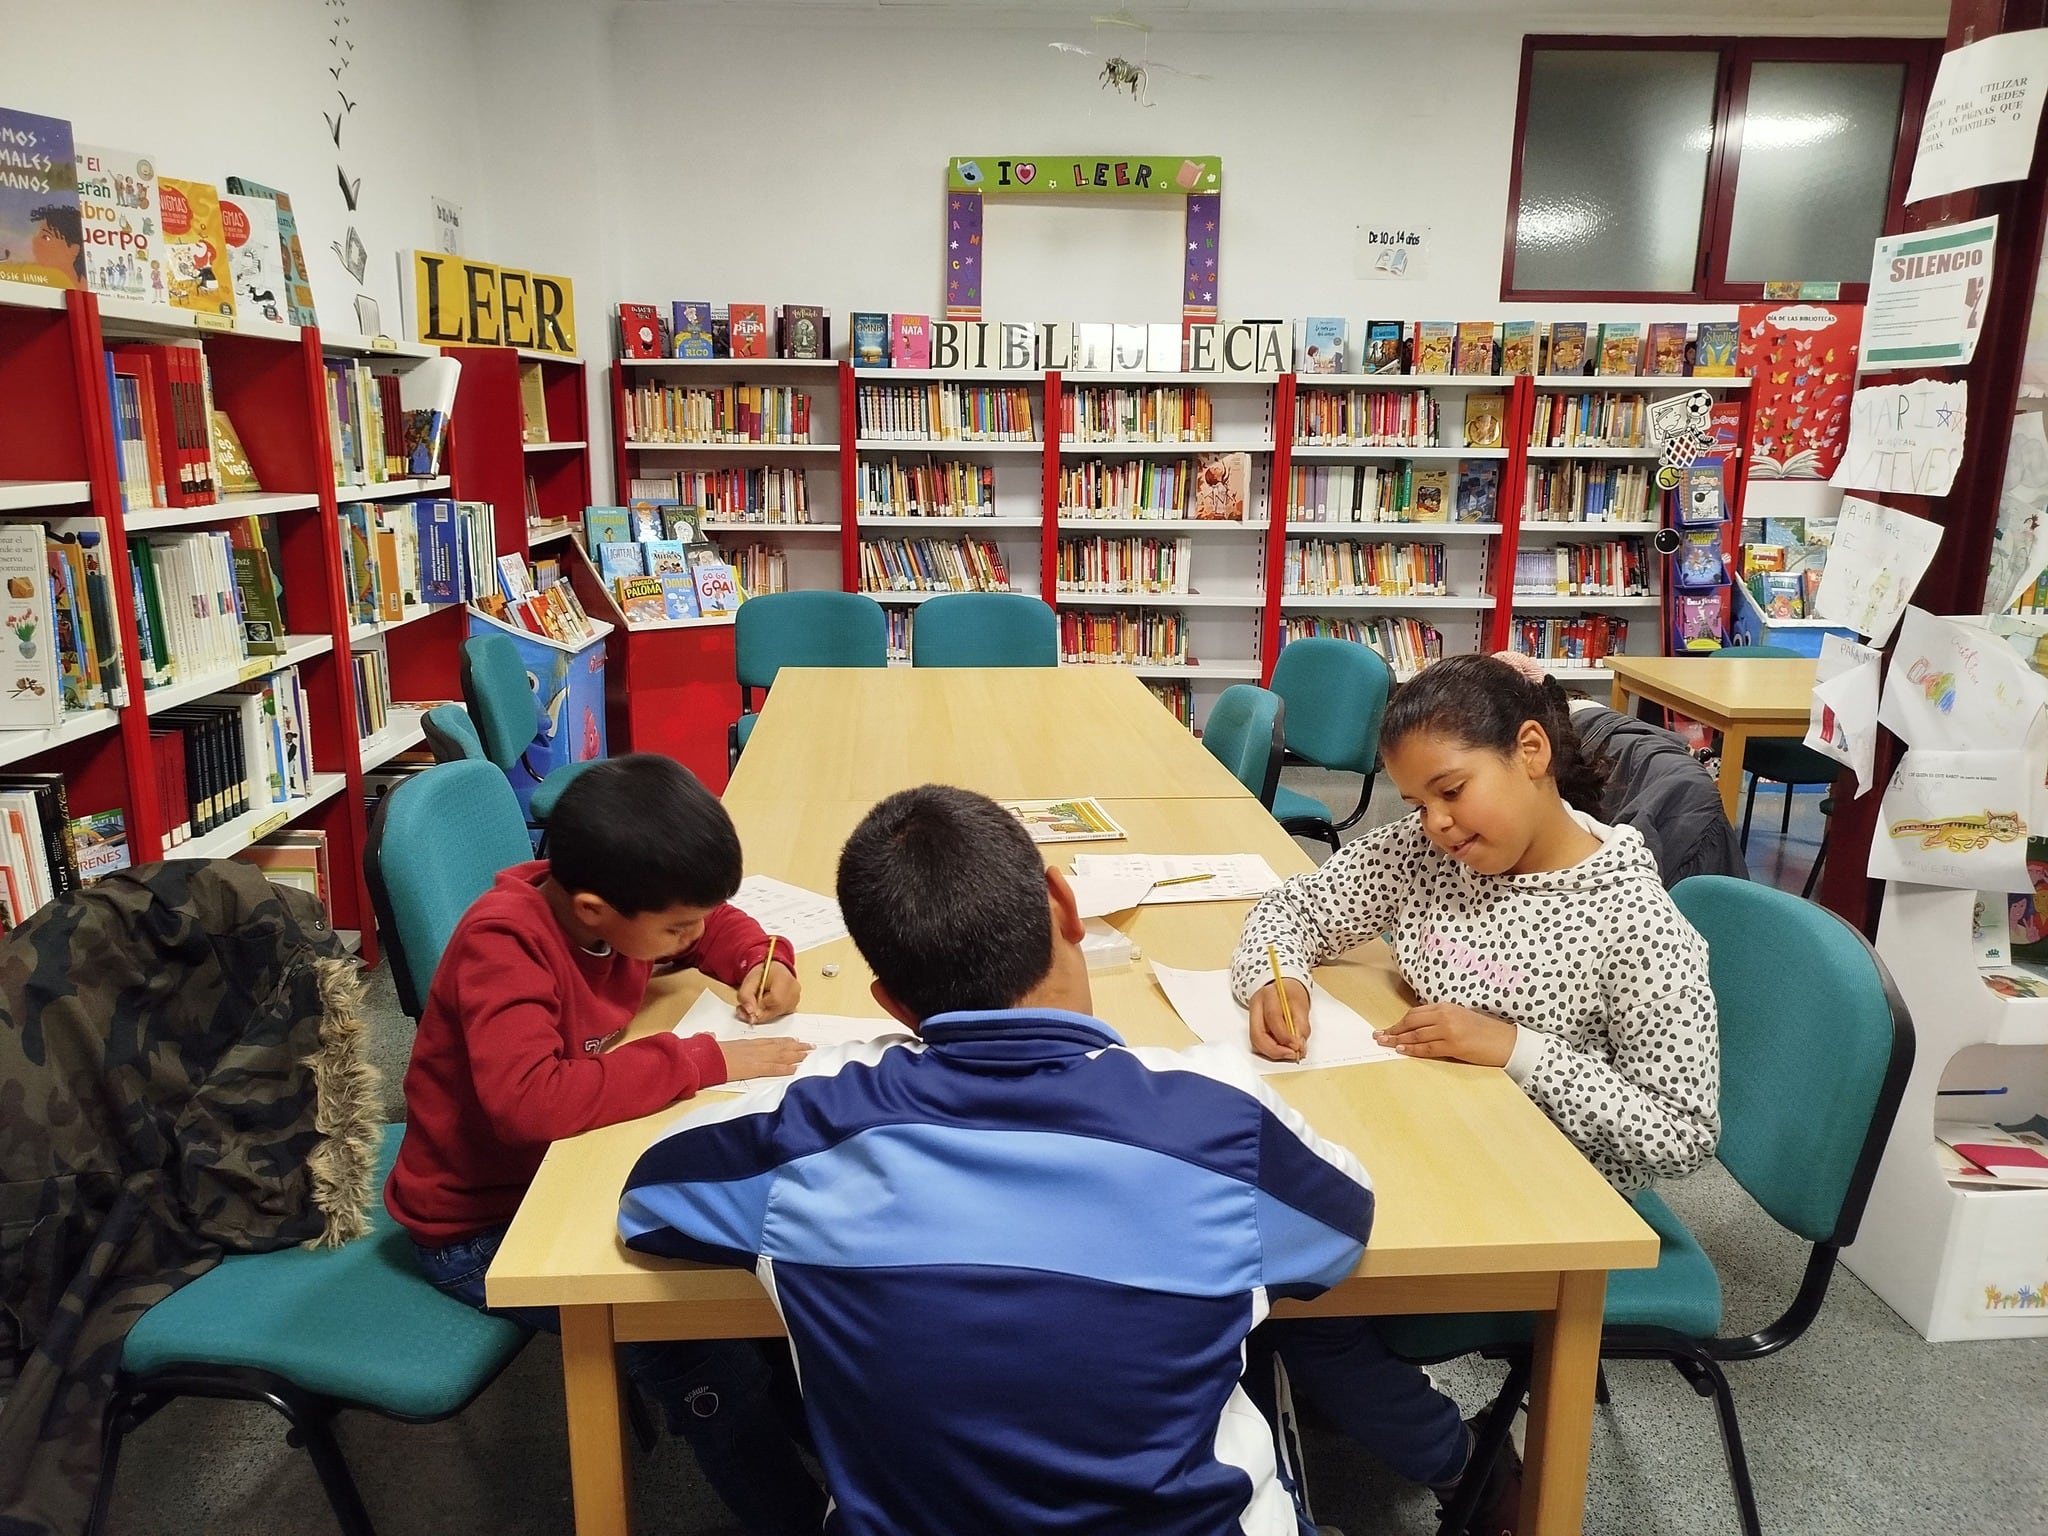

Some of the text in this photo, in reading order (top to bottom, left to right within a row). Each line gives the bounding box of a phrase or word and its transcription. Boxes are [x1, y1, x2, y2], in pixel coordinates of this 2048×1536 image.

[1980, 77, 2028, 96] UTILIZAR
[1991, 89, 2025, 103] REDES
[2000, 101, 2024, 113] QUE
[2012, 112, 2021, 121] O
[87, 157, 101, 172] El
[998, 161, 1153, 189] I LEER
[1368, 230, 1421, 246] De 10 a 14 años
[1889, 248, 1984, 284] SILENCIO
[420, 256, 574, 353] LEER
[901, 326, 923, 336] NATA
[931, 322, 1286, 371] BIBLIOECA
[233, 558, 251, 569] pas
[626, 584, 663, 599] PALOMA
